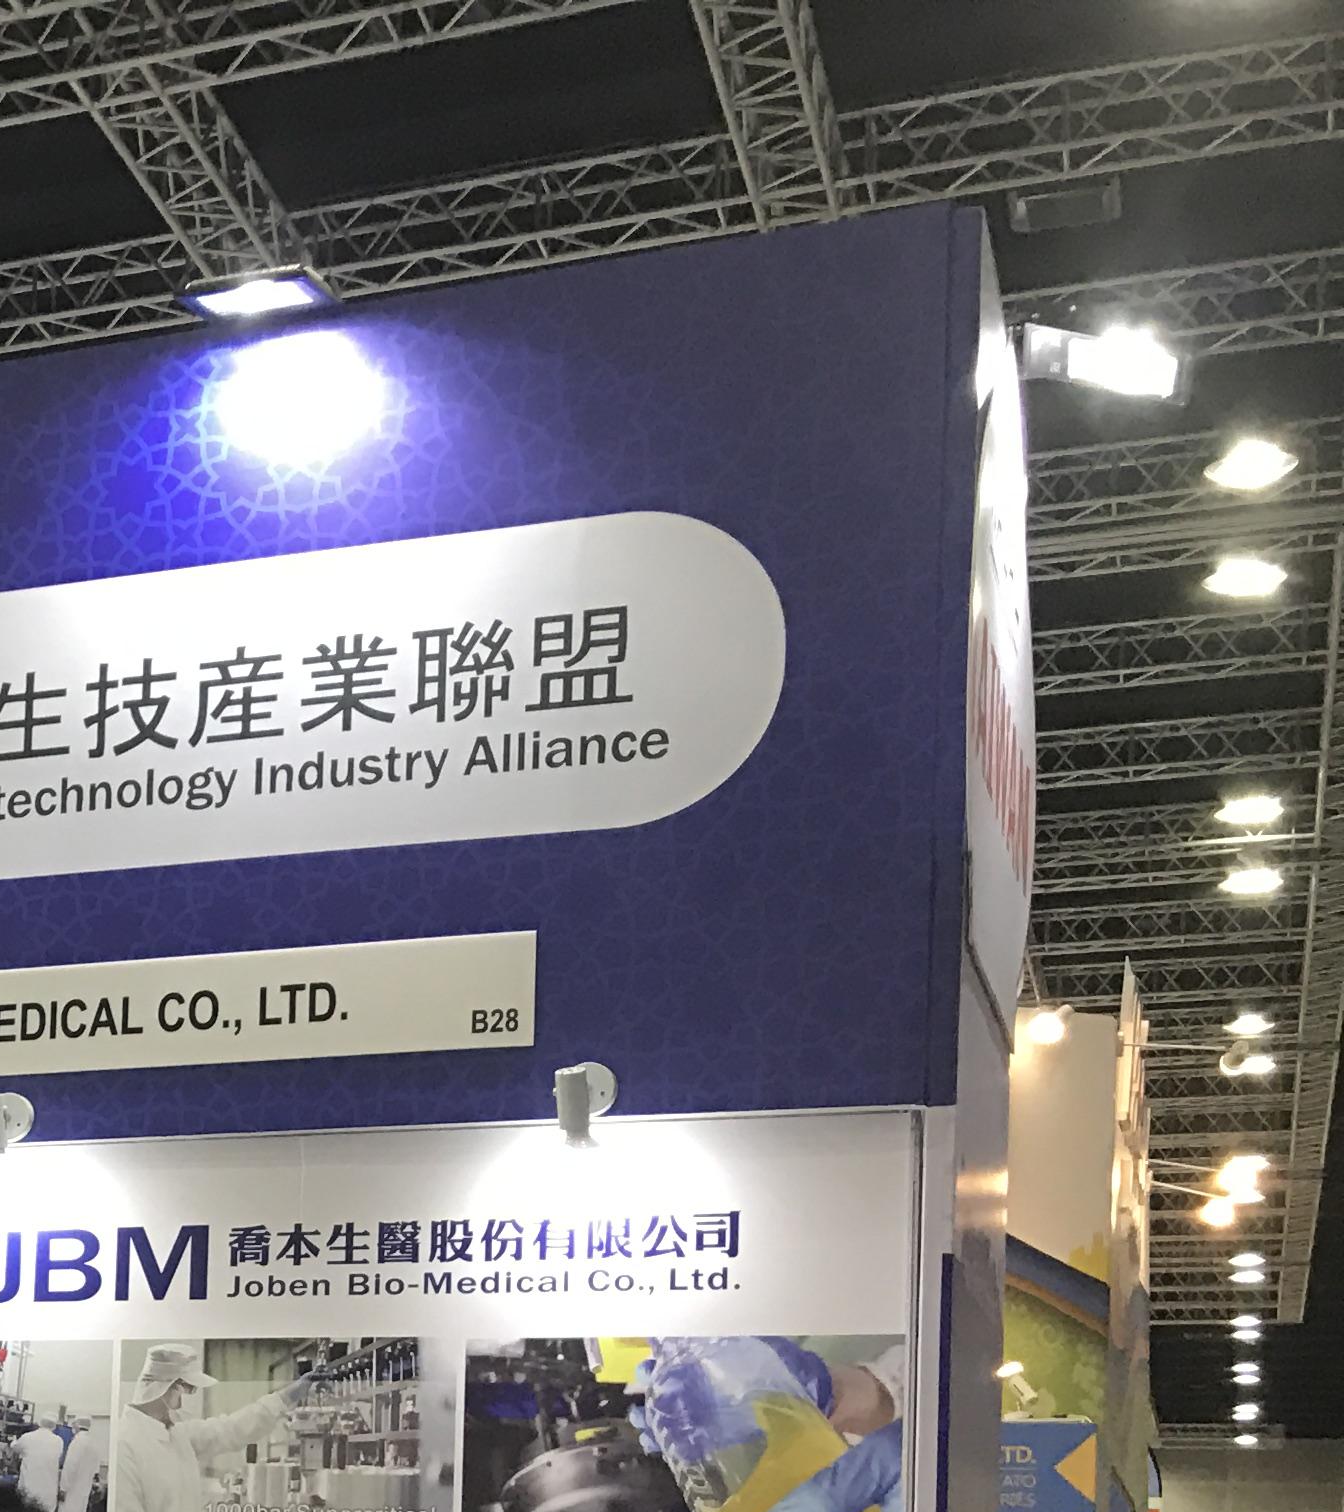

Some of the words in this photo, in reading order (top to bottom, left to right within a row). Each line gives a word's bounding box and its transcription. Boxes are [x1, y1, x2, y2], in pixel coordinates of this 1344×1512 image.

[253, 745, 450, 797] Industry
[463, 726, 671, 777] Alliance
[157, 990, 243, 1038] CO.,
[258, 981, 349, 1027] LTD.
[470, 1007, 520, 1035] B28
[227, 1209, 742, 1270] 喬本生醫股份有限公司
[226, 1272, 332, 1299] Joben
[347, 1269, 571, 1298] Bio-Medical
[586, 1268, 656, 1297] Co.,
[667, 1267, 742, 1293] Ltd.
[998, 1444, 1037, 1464] TD.
